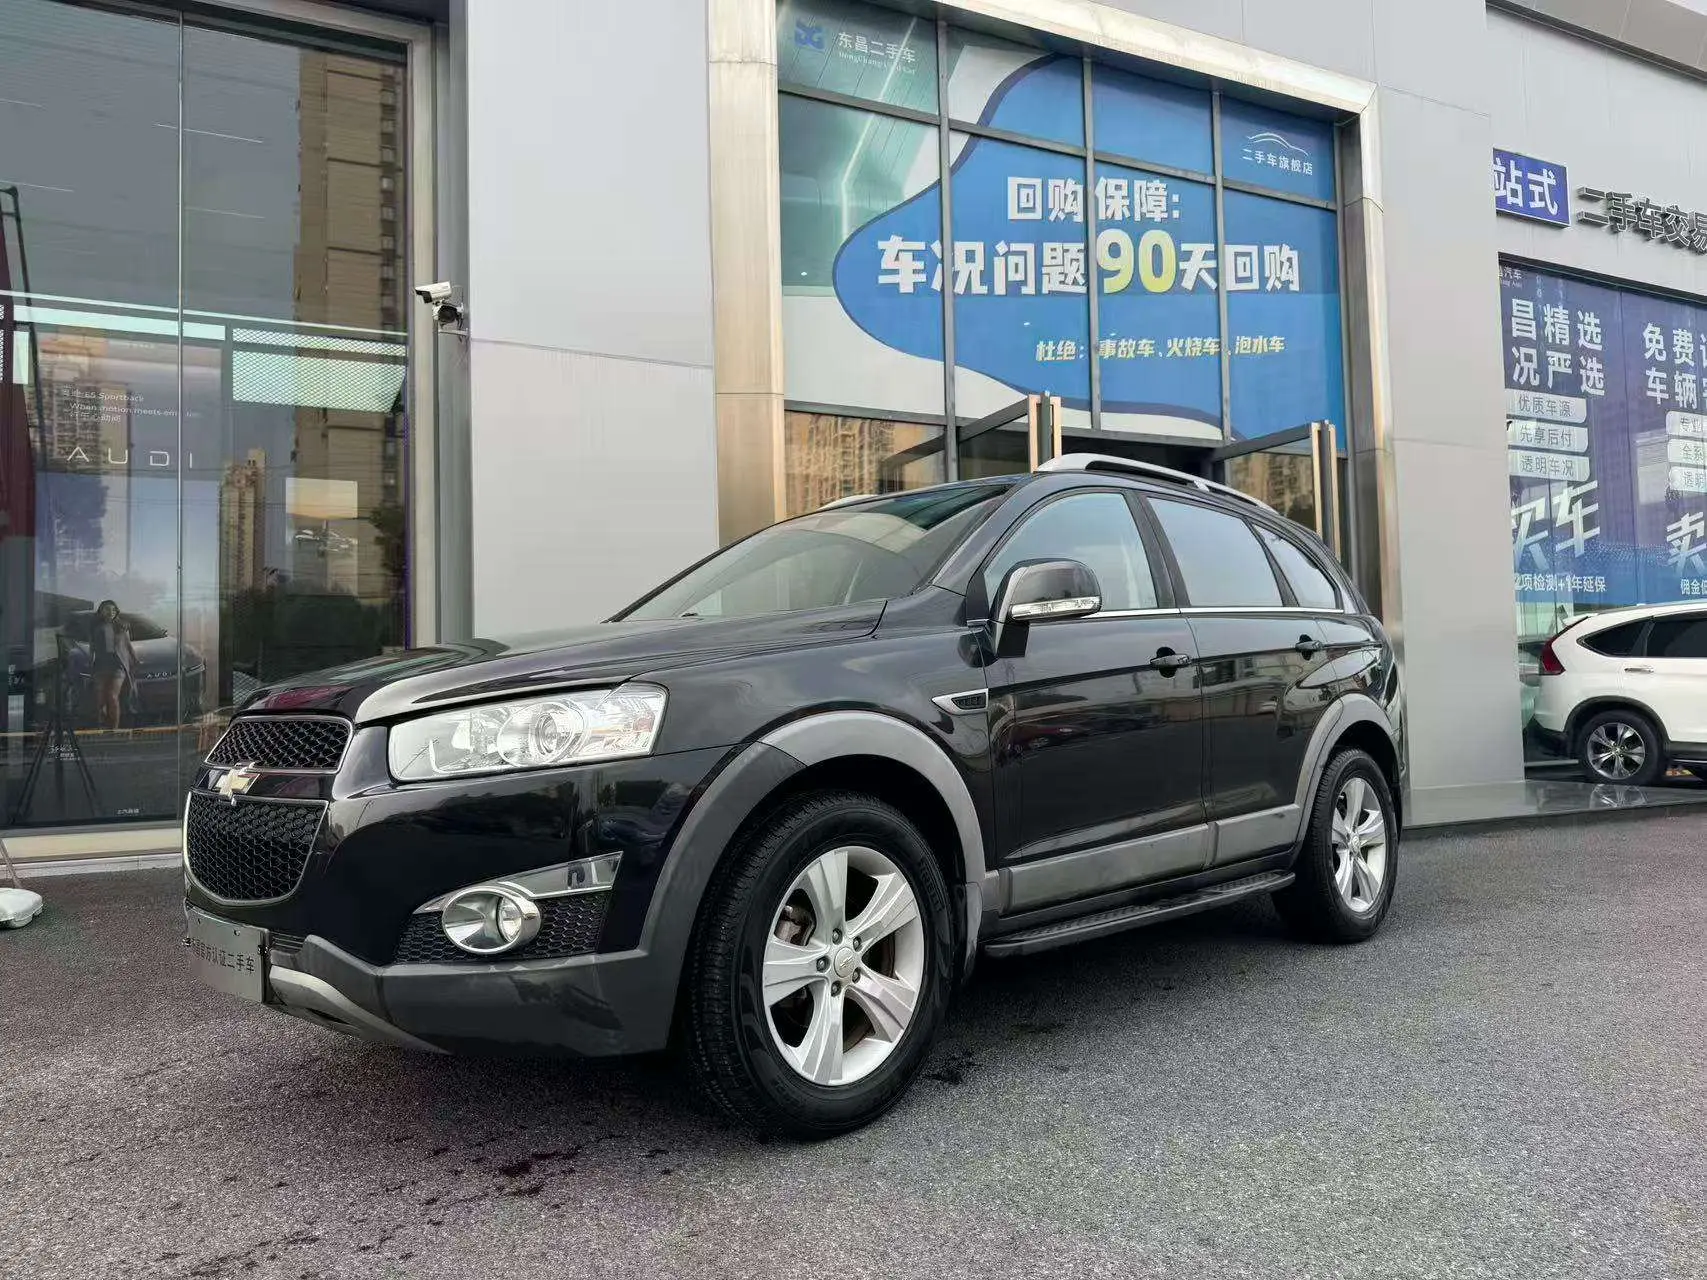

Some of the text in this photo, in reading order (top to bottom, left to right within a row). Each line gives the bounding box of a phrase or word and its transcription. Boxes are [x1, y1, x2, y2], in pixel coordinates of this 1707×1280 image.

[838, 31, 916, 63] 东昌二手车
[1242, 148, 1313, 175] 二手车旗舰店
[1007, 176, 1180, 223] 回购保障：
[1493, 157, 1558, 216] 站式
[877, 228, 1300, 296] 车况问题90天回购
[1511, 299, 1603, 351] 昌精选
[1512, 346, 1605, 396] 况严选
[1645, 367, 1707, 409] 车辆
[1519, 394, 1571, 417] 优质车源
[1520, 424, 1572, 447] 先享后付
[67, 446, 193, 468] AUDI
[1521, 455, 1575, 477] 透明车况
[1511, 480, 1600, 570] 买车
